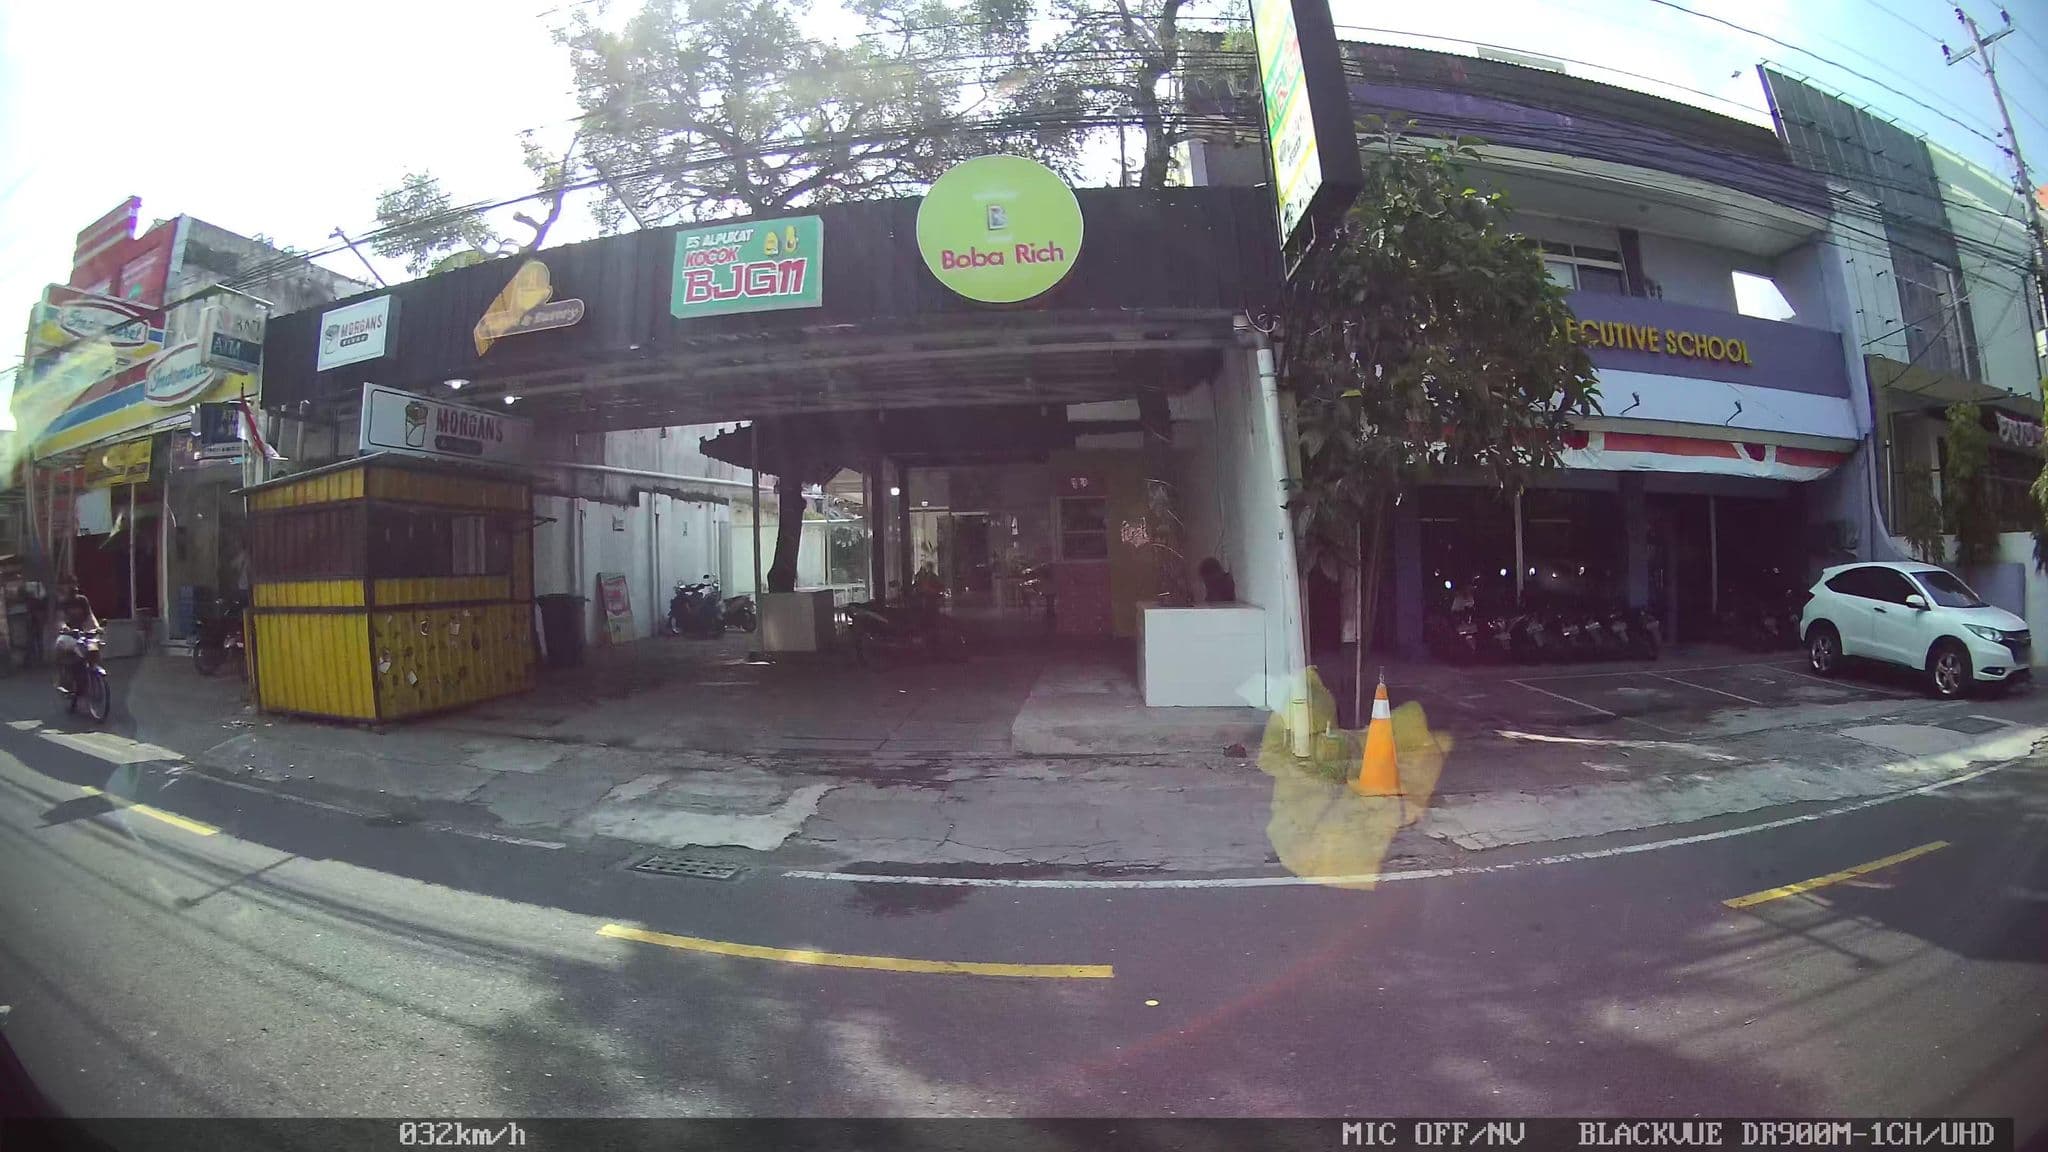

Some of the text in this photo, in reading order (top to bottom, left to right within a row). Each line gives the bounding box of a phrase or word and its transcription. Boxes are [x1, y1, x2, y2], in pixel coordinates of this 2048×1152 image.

[686, 229, 754, 249] ES ALPUKAT
[684, 244, 742, 269] KOCOK
[941, 240, 1065, 270] Boba Rich
[340, 314, 383, 338] MORGANS
[1665, 329, 1753, 367] SCHOOL
[436, 406, 504, 442] MORGANS
